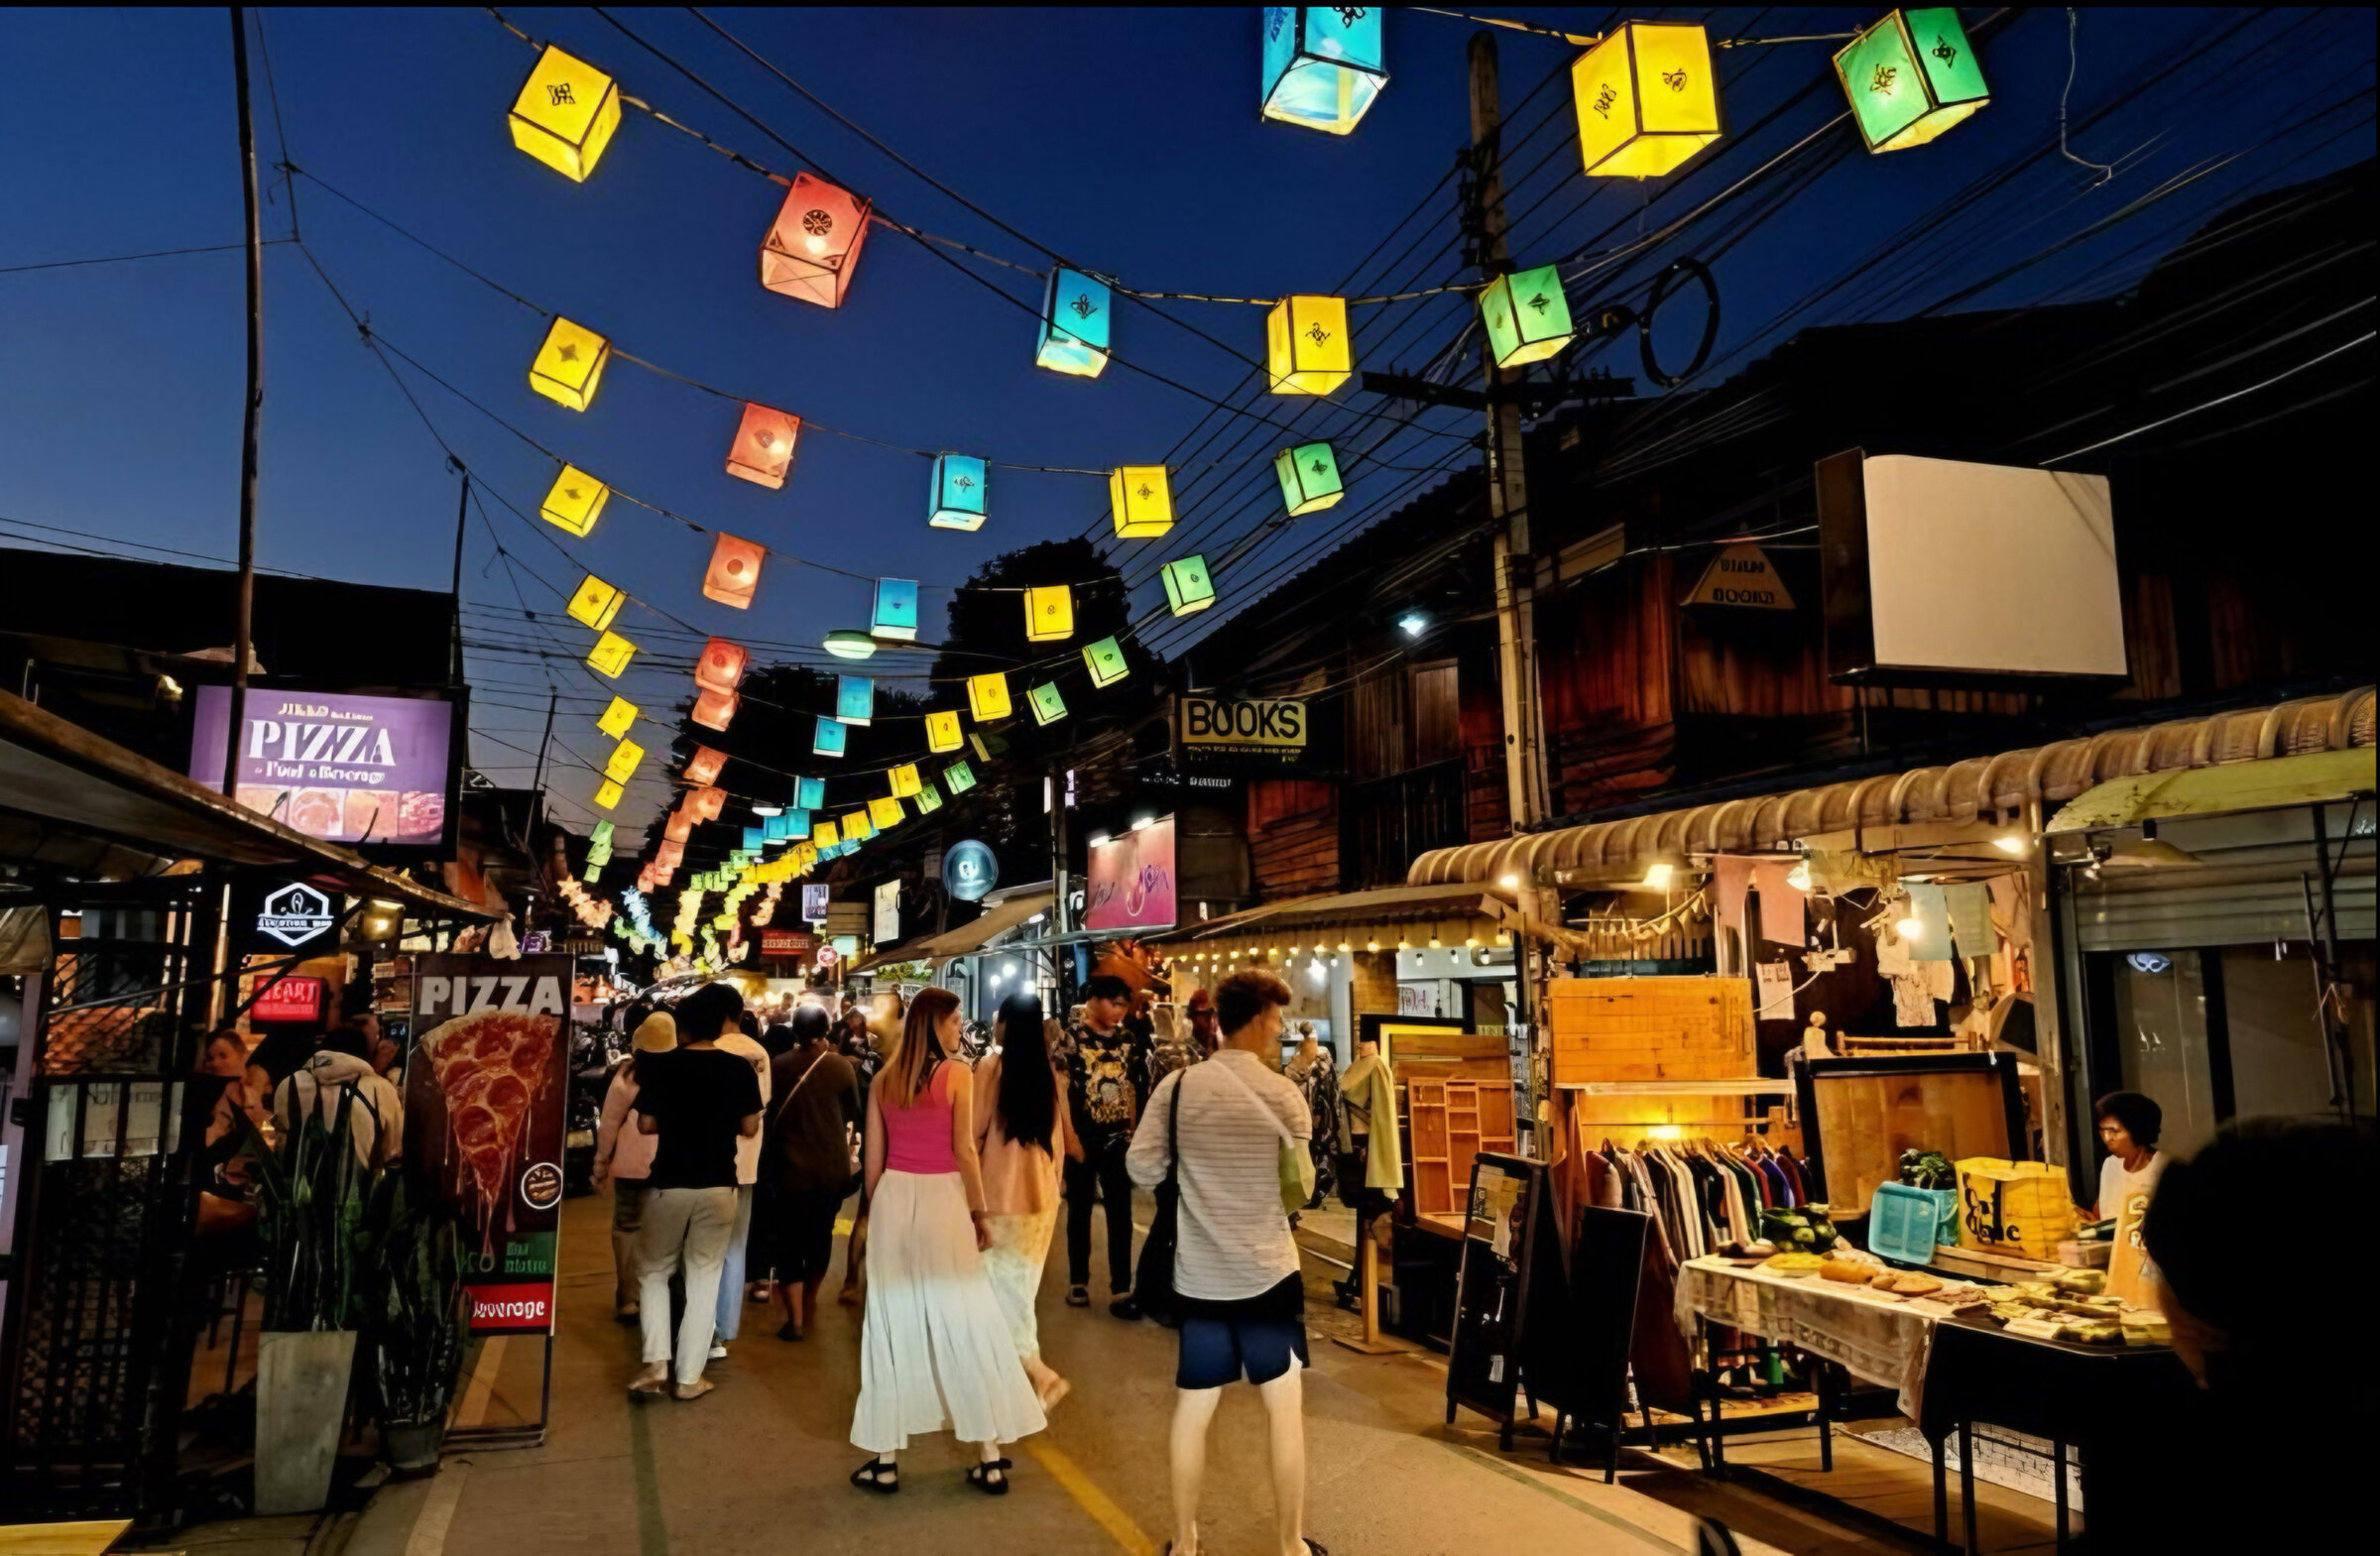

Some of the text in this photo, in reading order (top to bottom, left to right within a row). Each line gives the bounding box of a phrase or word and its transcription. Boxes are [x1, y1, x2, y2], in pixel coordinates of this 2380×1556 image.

[1187, 699, 1301, 739] BOOKS
[248, 719, 396, 766] PIZZA
[418, 976, 564, 1017] PIZZA
